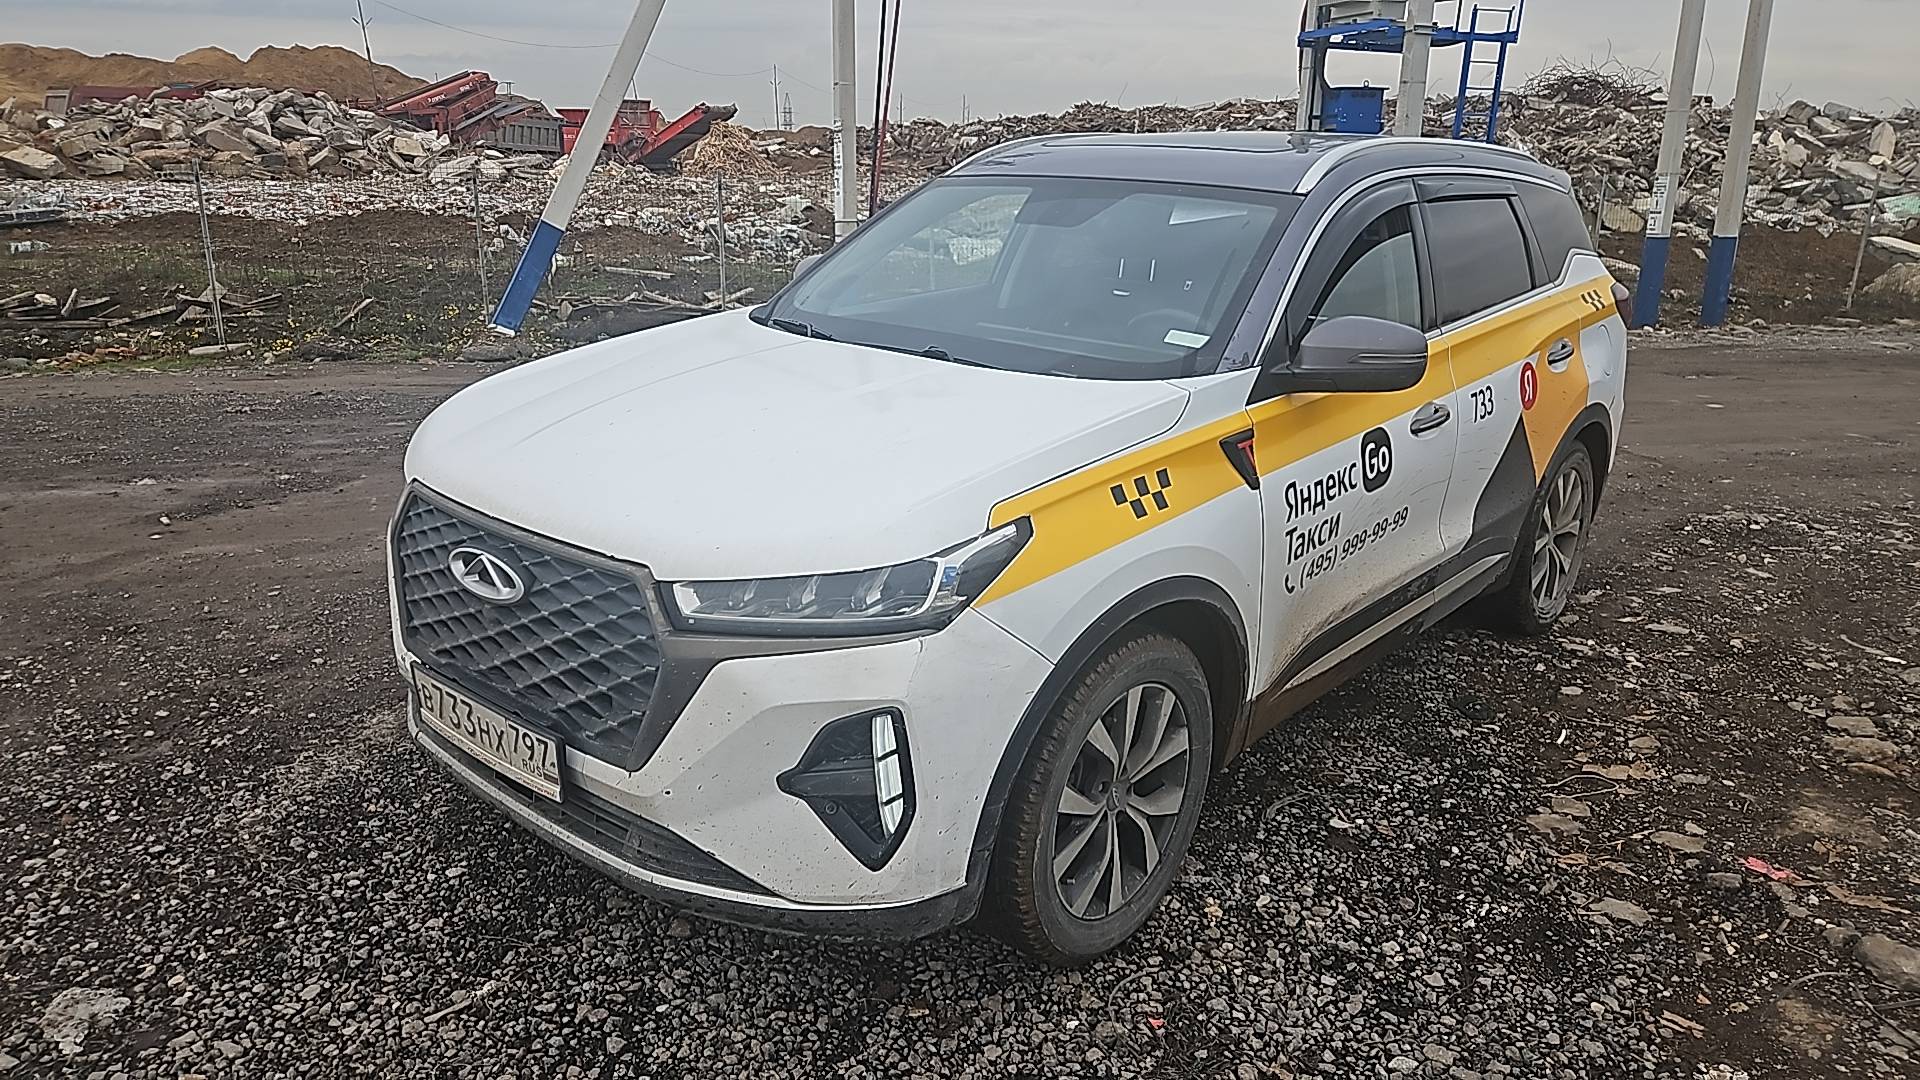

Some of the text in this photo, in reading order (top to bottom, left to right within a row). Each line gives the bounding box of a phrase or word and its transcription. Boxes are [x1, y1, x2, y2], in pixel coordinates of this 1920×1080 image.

[1470, 385, 1494, 424] 733
[1524, 369, 1533, 402] Я
[1284, 441, 1390, 524] Яндекс Go
[1284, 511, 1342, 565] Такси
[1299, 505, 1409, 589] (495) 999-99-99
[521, 758, 543, 778] RUS
